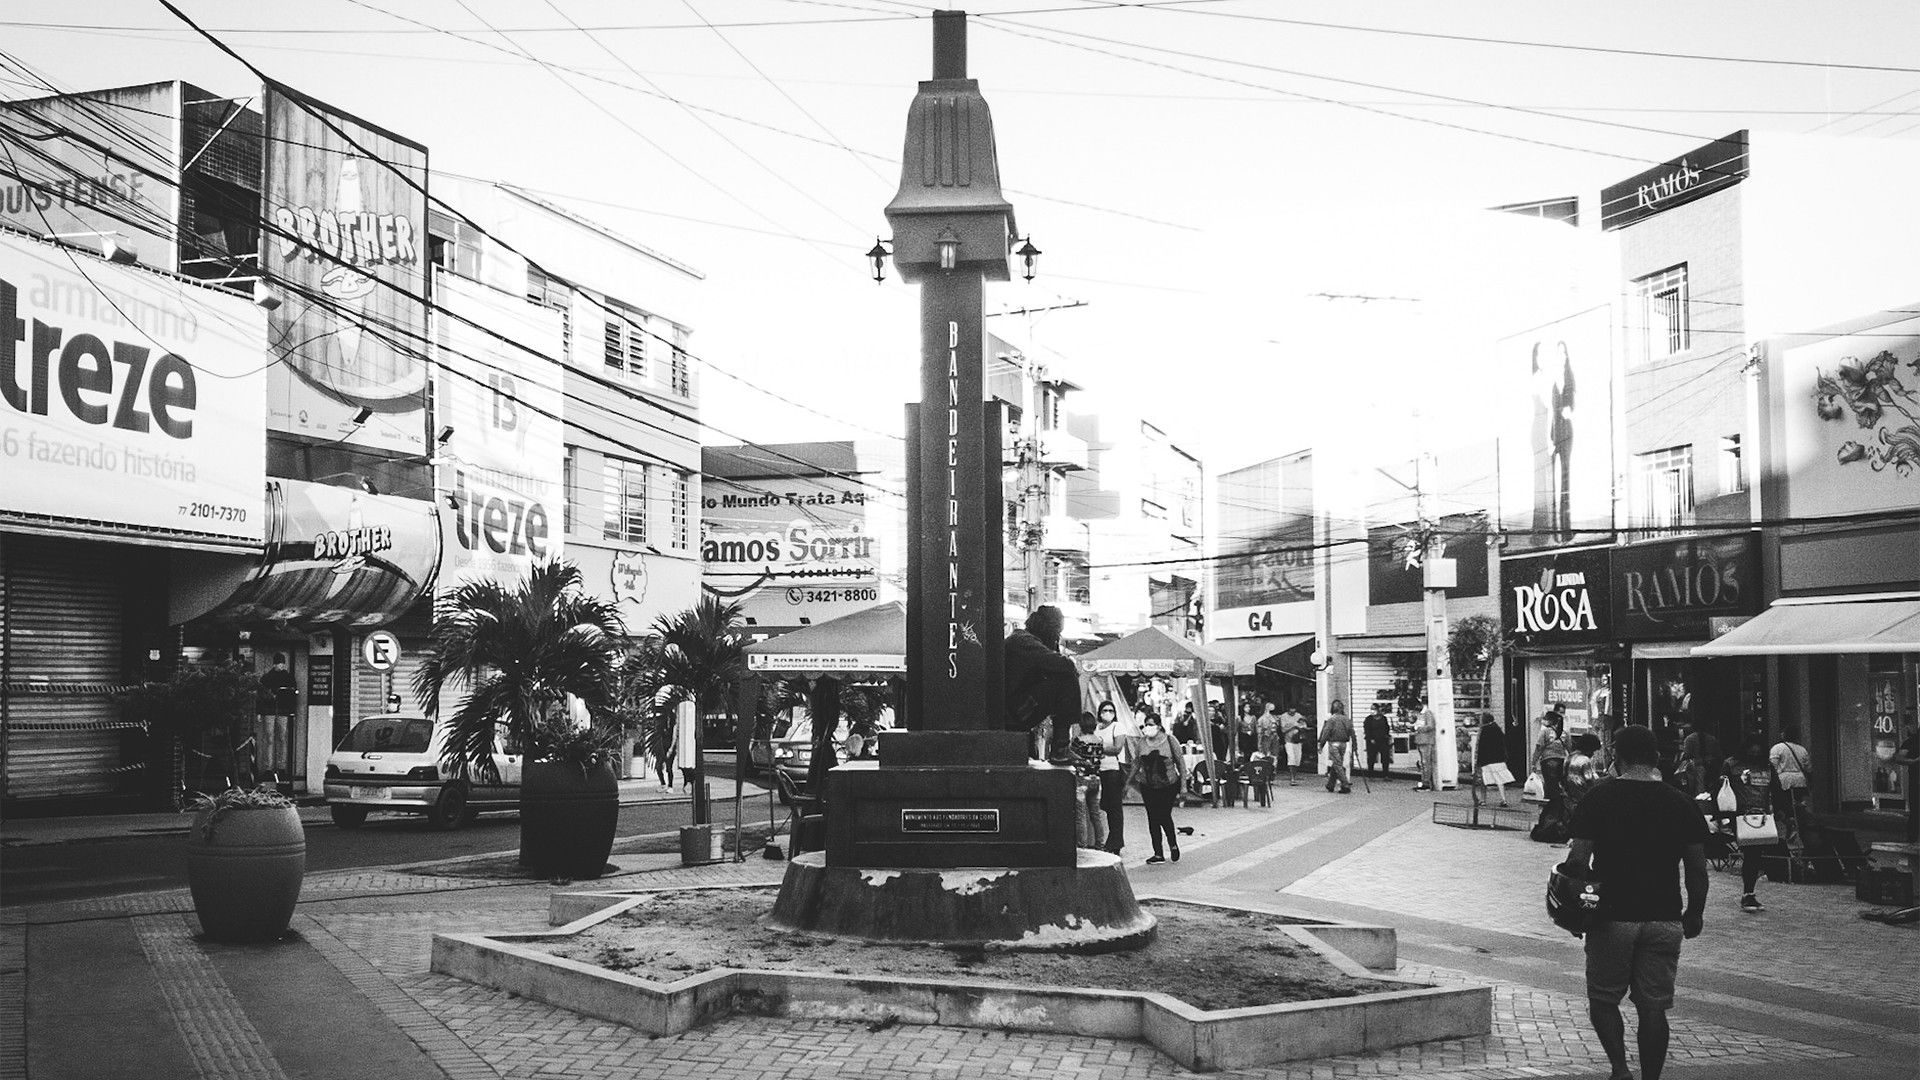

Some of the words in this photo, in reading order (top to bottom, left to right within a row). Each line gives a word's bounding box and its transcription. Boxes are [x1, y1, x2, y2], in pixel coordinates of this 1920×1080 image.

[0, 172, 144, 215] UISTENSE
[1638, 164, 1700, 211] RAMOS
[276, 206, 418, 267] BROTHER
[29, 272, 199, 344] armarinho
[0, 277, 197, 439] treze
[28, 430, 118, 472] fazendo
[123, 446, 197, 483] história
[190, 502, 247, 523] 2101-7370
[456, 470, 549, 558] treze
[722, 492, 781, 508] Mundo
[785, 491, 836, 508] Trata
[948, 320, 960, 680] BANDEIRANTES
[313, 525, 392, 561] BROTHER
[702, 538, 781, 562] amos
[789, 525, 875, 562] Sorrir
[806, 589, 877, 603] 3421-8800
[1556, 572, 1586, 587] LINDA
[1623, 562, 1740, 622] RAMOS
[1248, 611, 1273, 631] G4
[1513, 583, 1598, 633] ROSA
[373, 640, 389, 664] E
[1548, 691, 1583, 703] ESTOQUE
[1552, 679, 1577, 691] LIMPA
